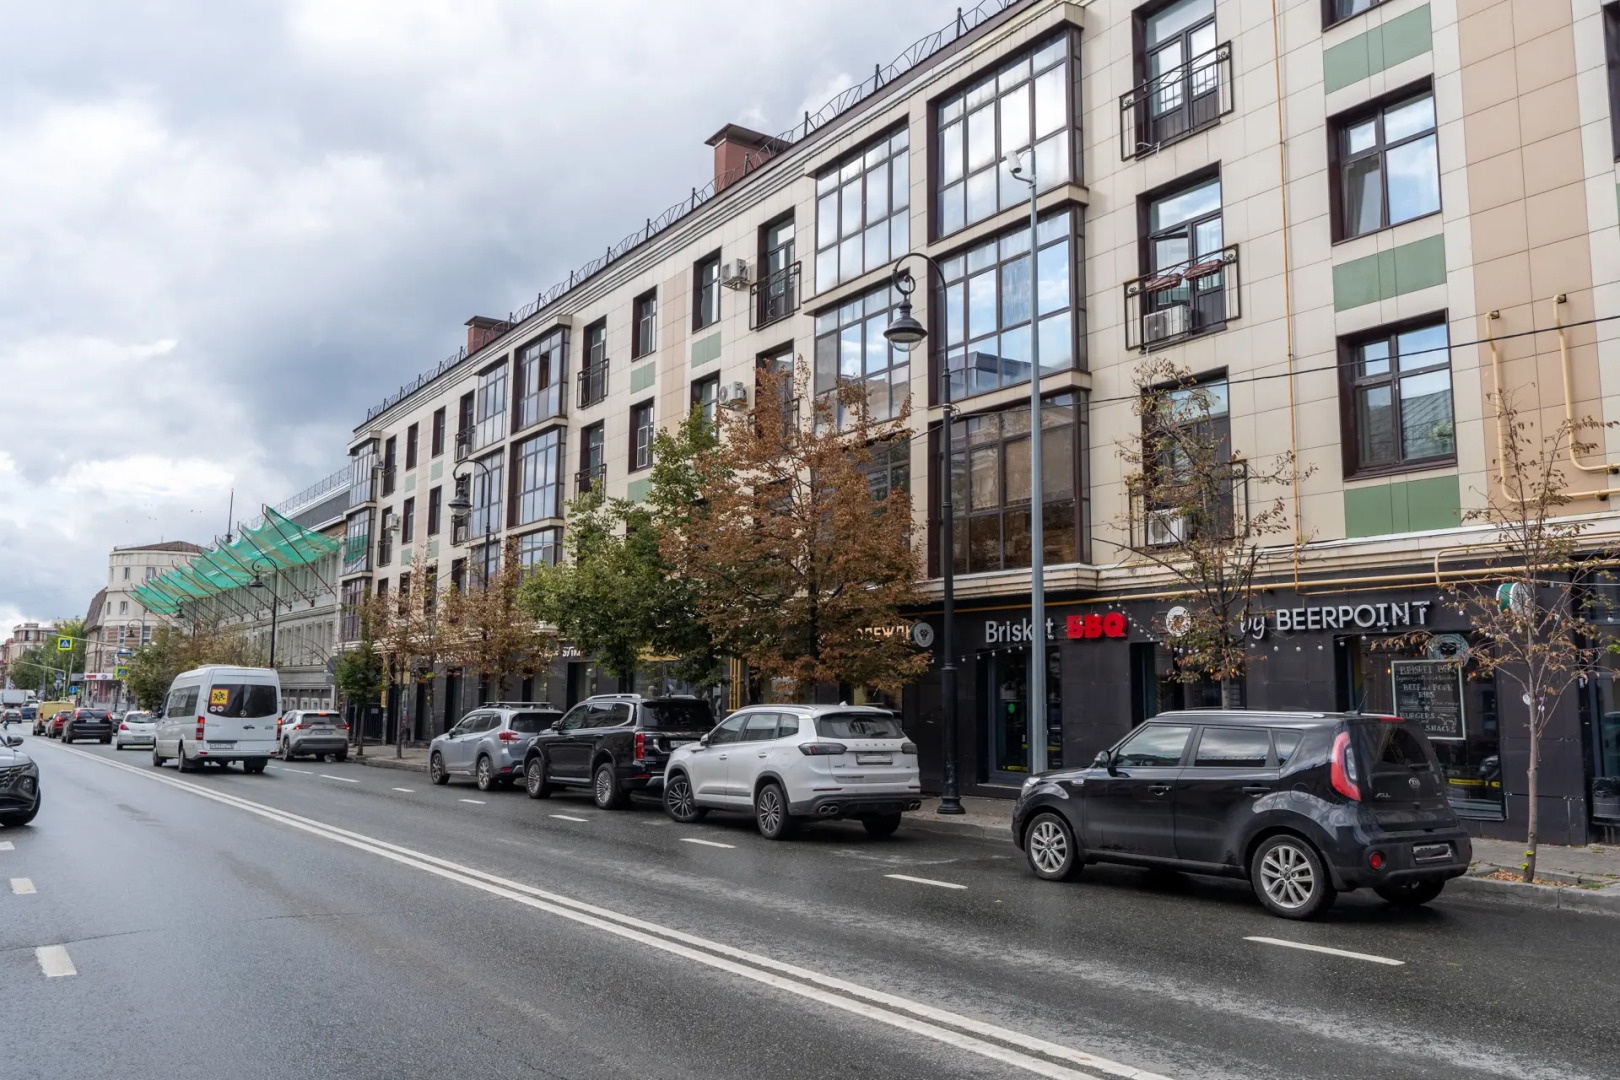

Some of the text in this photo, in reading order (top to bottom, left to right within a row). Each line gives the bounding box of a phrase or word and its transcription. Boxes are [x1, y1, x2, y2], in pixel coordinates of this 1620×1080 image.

[985, 617, 1054, 643] Briskt
[1066, 612, 1127, 639] BBQ
[1276, 601, 1431, 632] BEERPOINT
[1400, 666, 1432, 674] BRISKET
